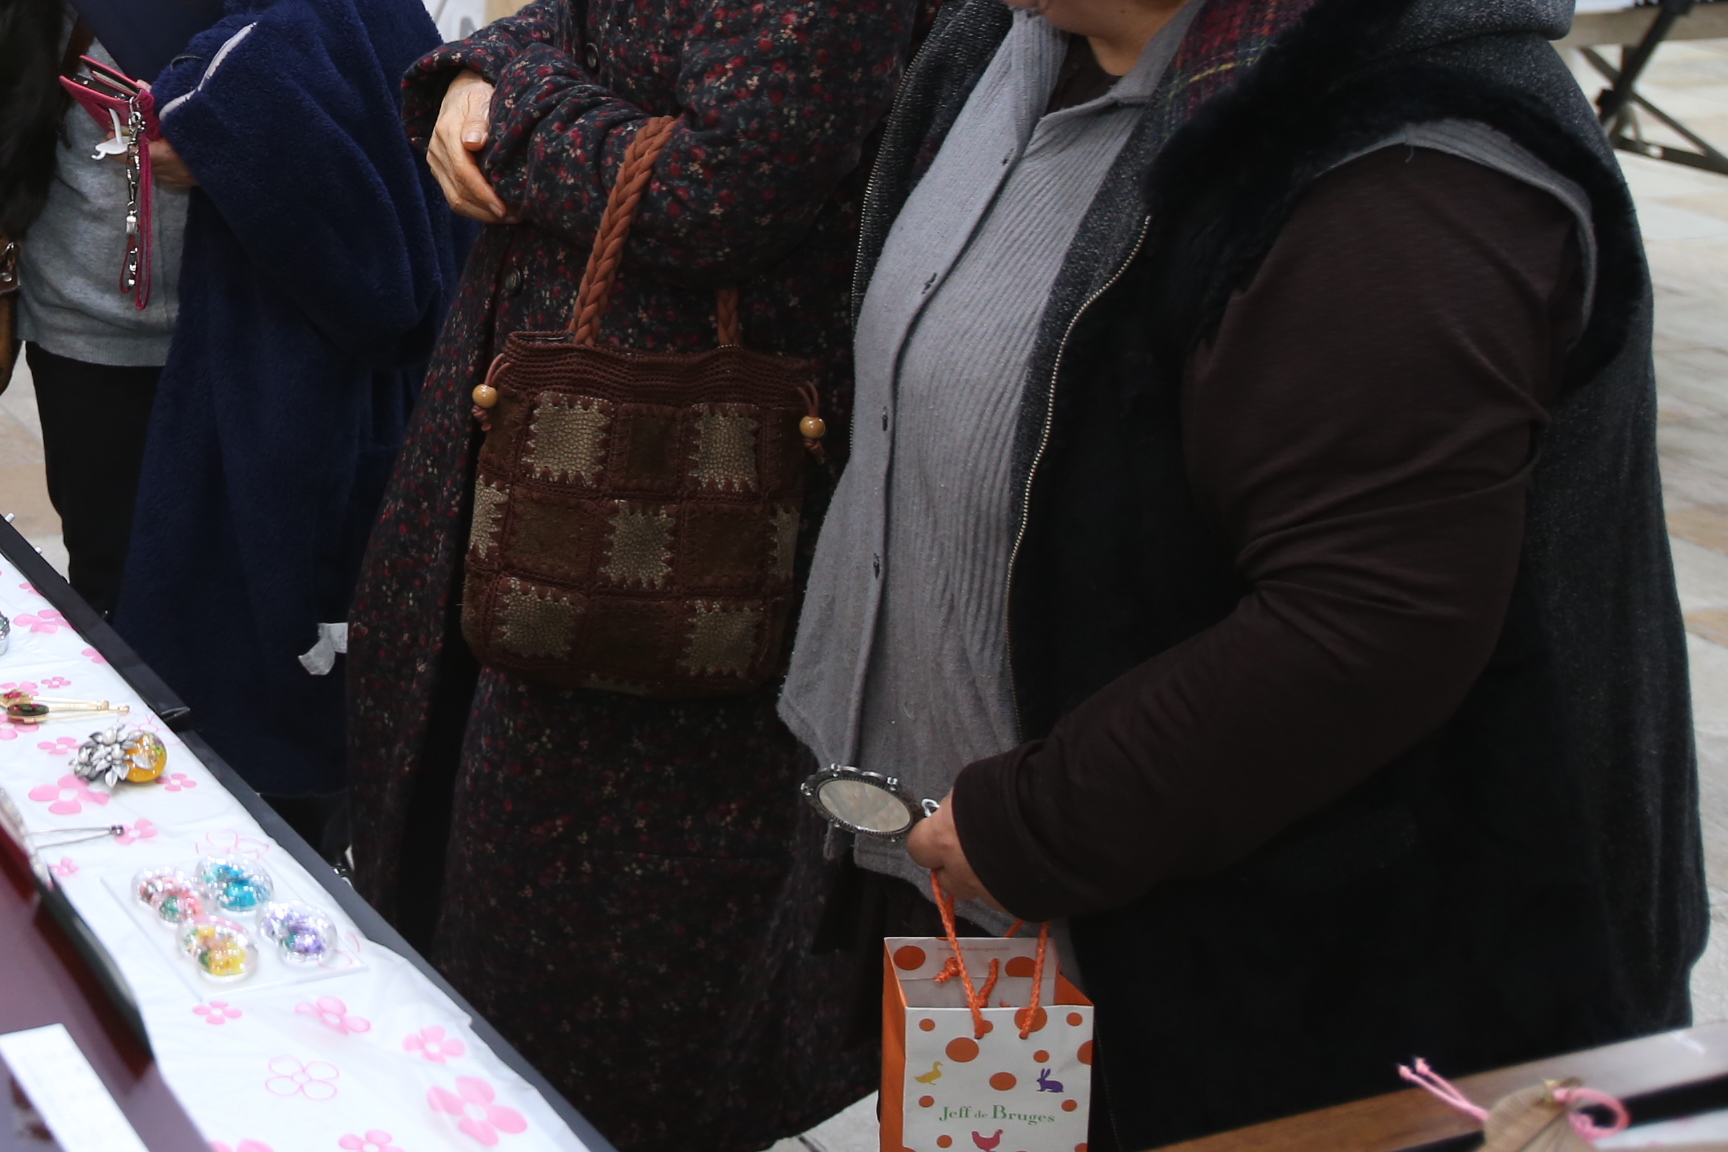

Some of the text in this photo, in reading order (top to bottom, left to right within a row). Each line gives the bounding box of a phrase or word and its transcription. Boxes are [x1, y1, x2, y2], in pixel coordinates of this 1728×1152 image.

[938, 1104, 1055, 1126] Jeff de Bruges
